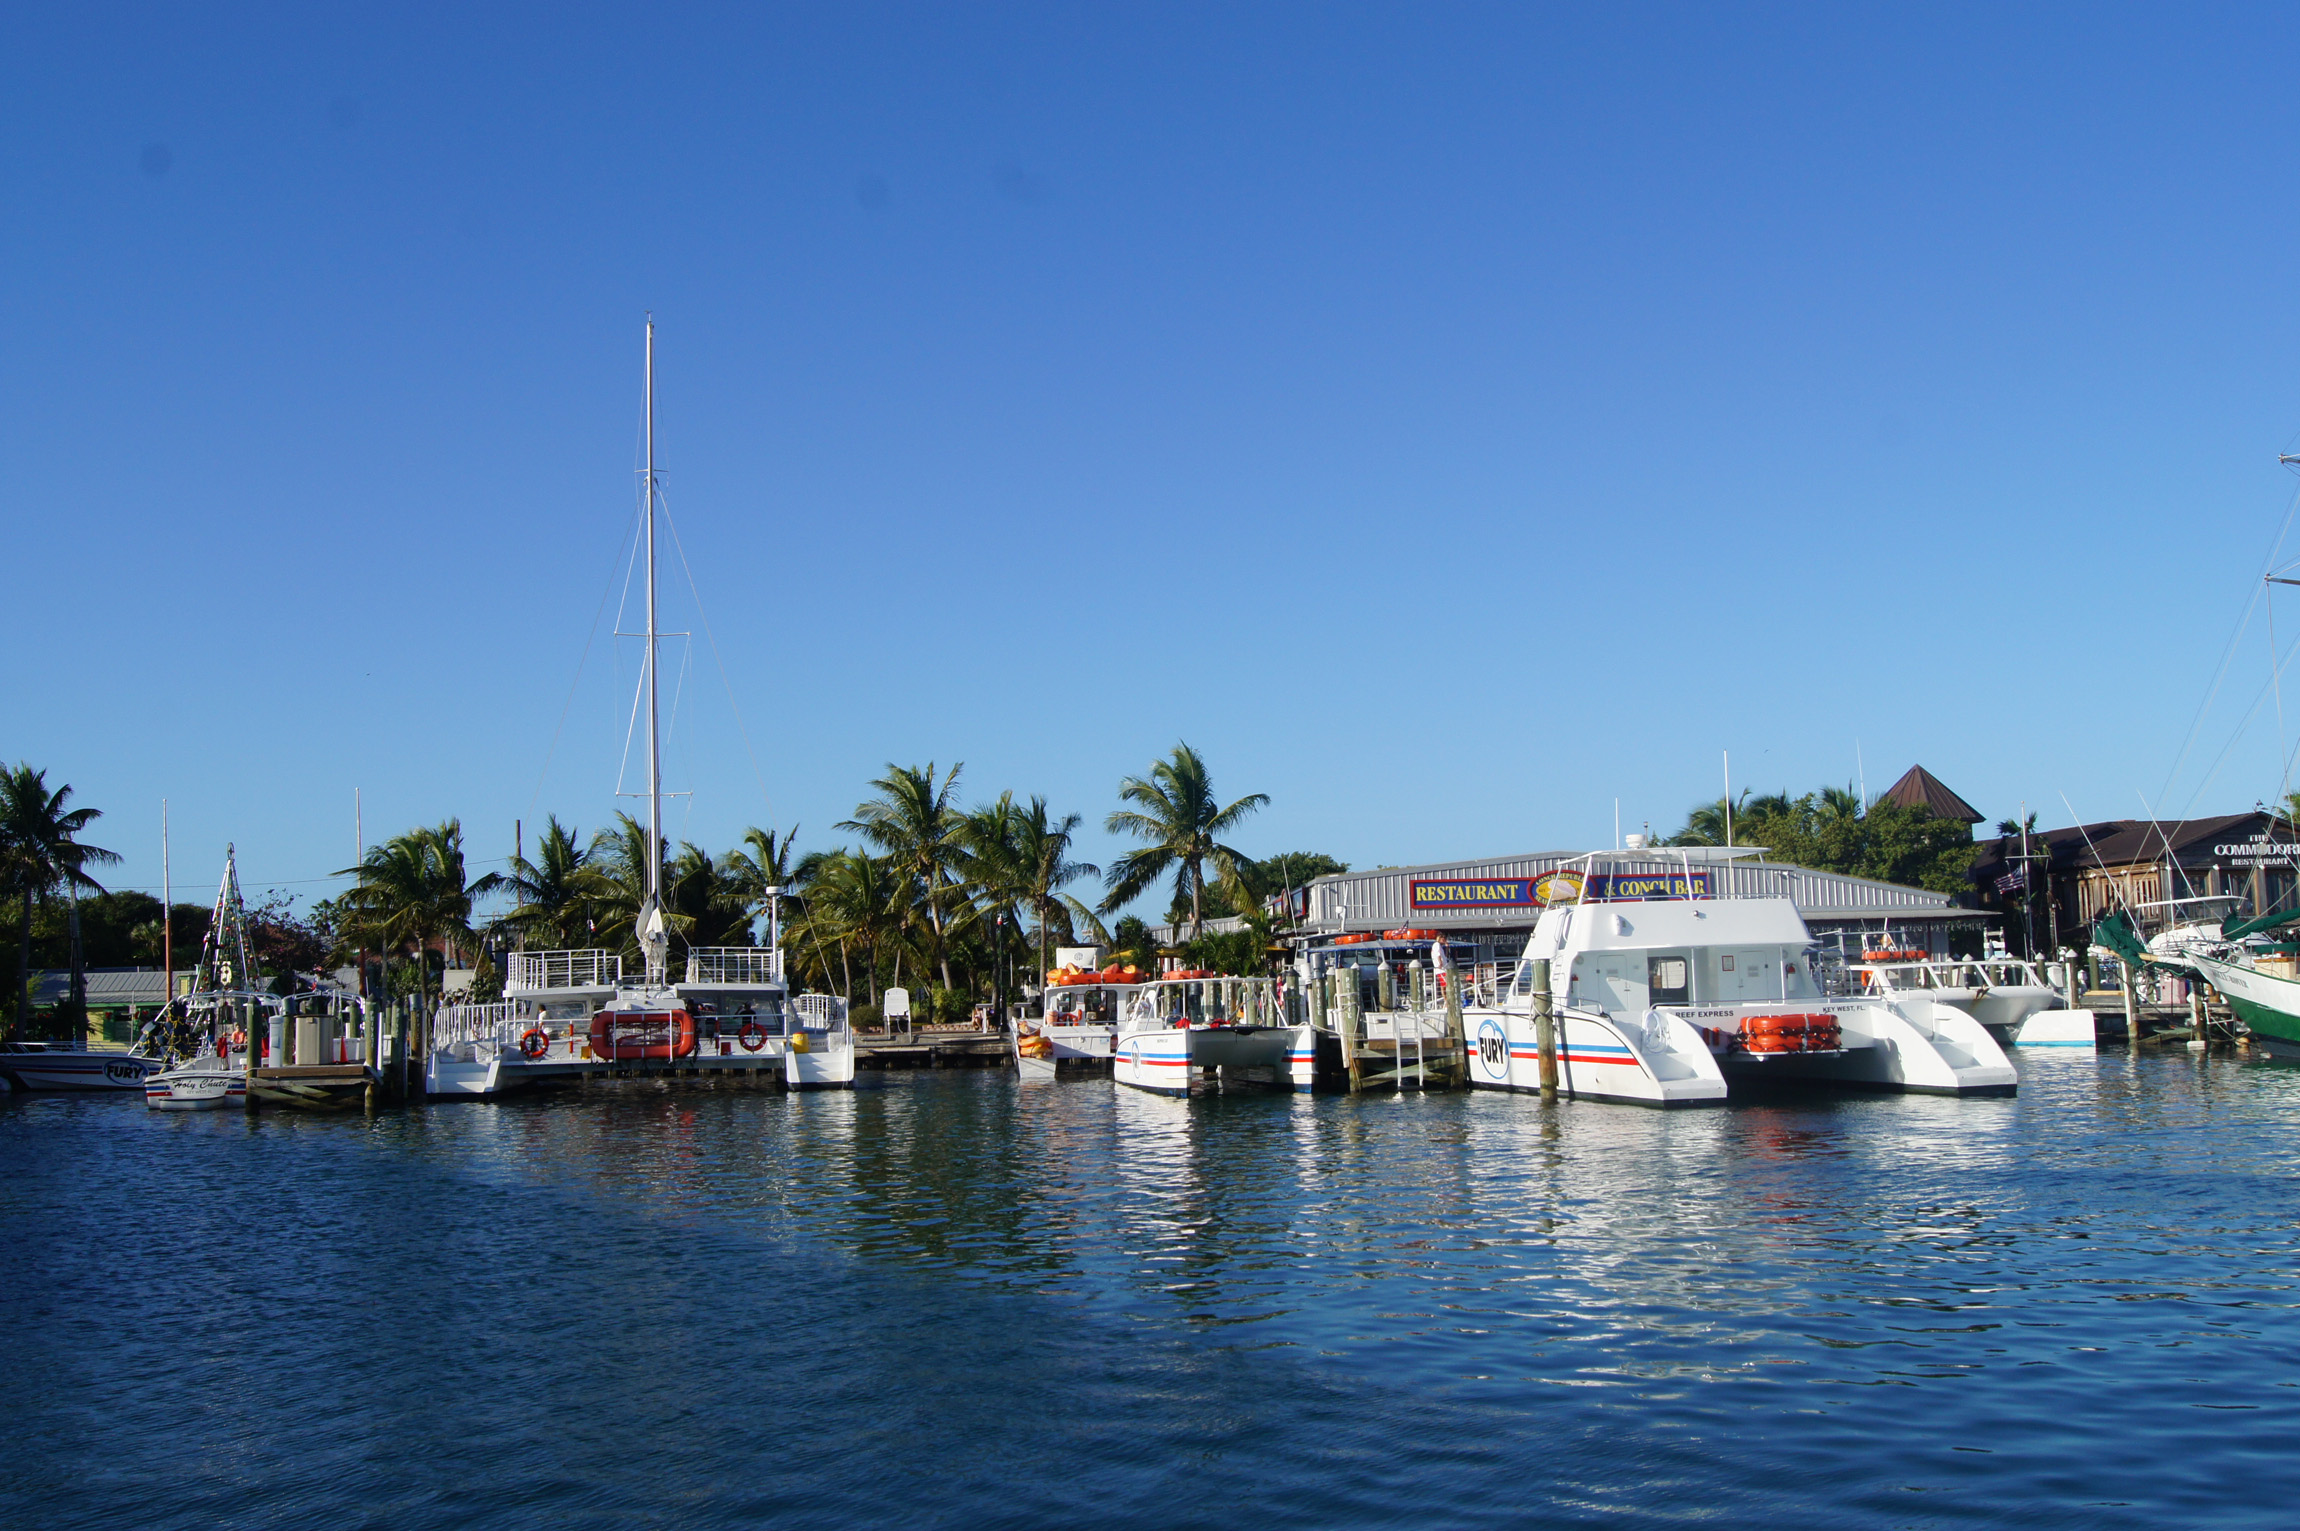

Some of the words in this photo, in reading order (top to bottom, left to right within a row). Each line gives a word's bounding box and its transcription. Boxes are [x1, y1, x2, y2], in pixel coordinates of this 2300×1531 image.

[2248, 834, 2269, 842] THE
[2213, 844, 2300, 856] COMMDOR
[2231, 857, 2287, 866] RESTAURANT
[1415, 884, 1519, 902] RESTAURANT
[1604, 882, 1616, 896] &
[1674, 880, 1705, 895] BAR
[1698, 1010, 1734, 1018] EXPRESS
[1479, 1037, 1504, 1065] FURY
[107, 1065, 143, 1079] FURY
[173, 1080, 196, 1090] Holy
[199, 1079, 228, 1089] Chute
